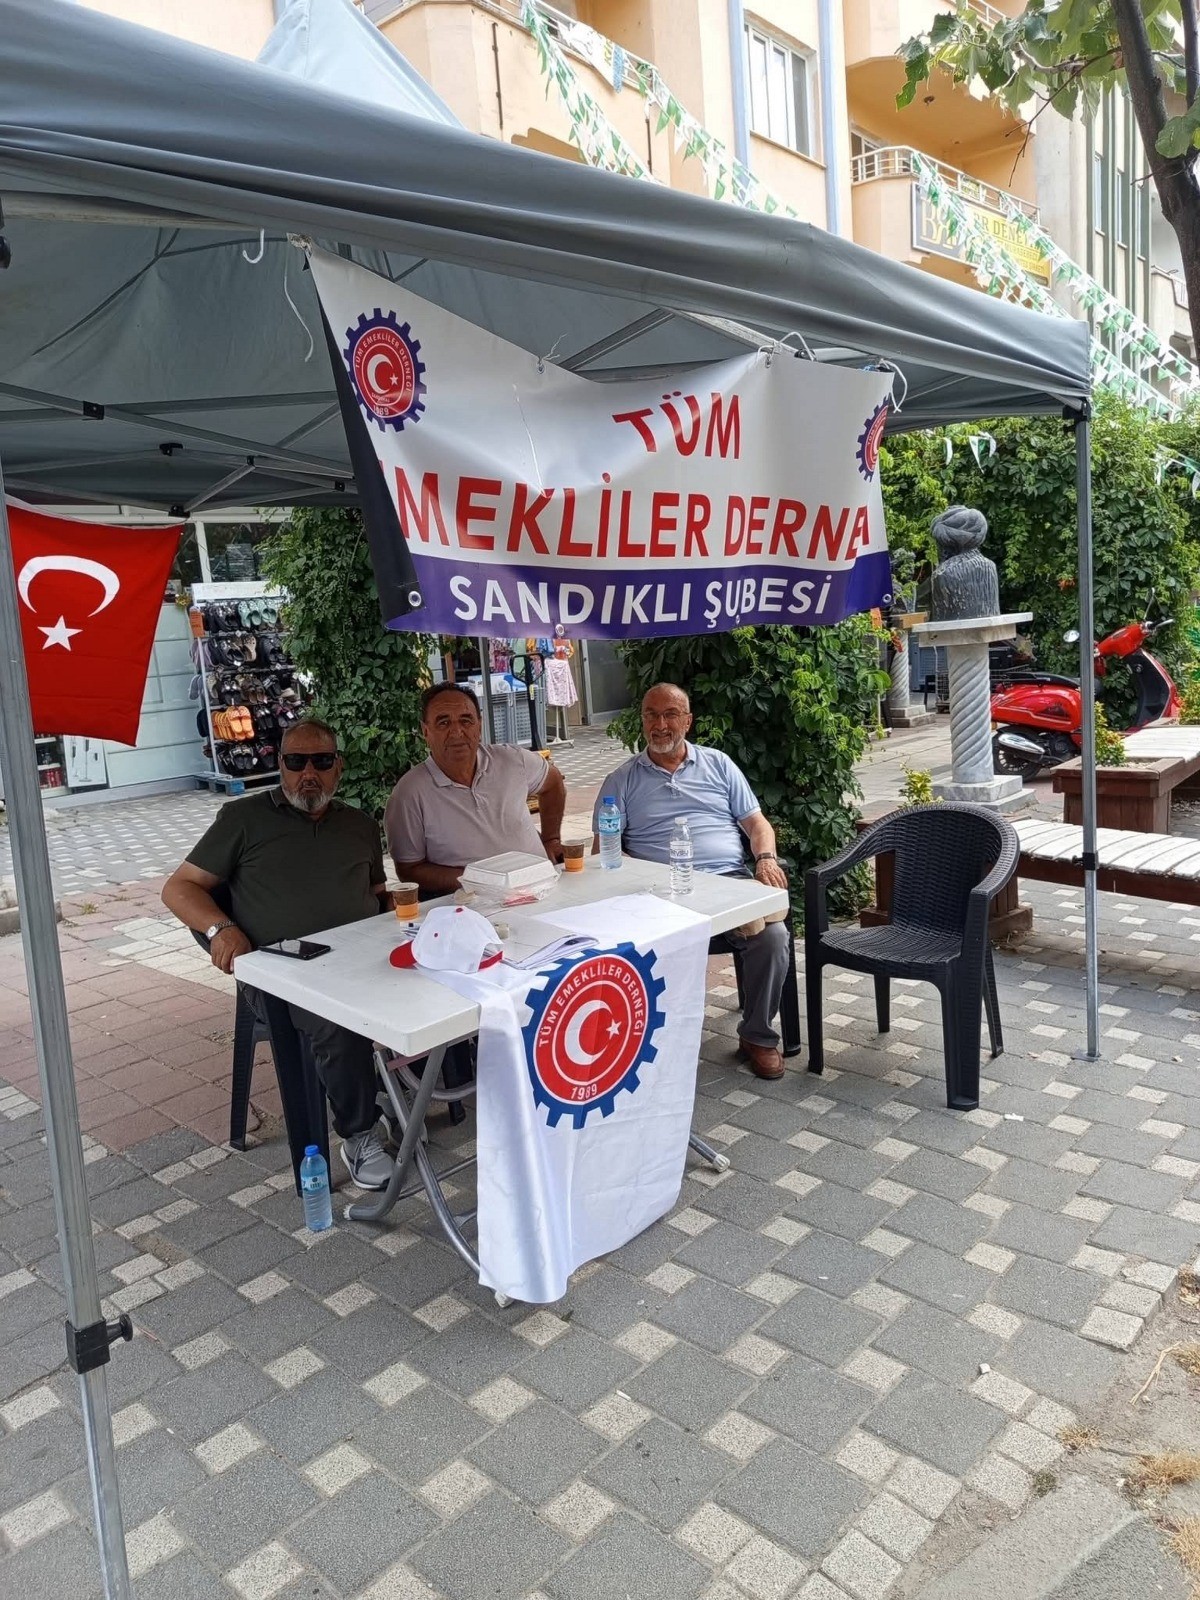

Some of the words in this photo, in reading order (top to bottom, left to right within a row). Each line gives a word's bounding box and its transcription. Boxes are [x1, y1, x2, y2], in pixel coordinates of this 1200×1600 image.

[362, 333, 400, 348] EMEKLİLER
[373, 404, 390, 416] 1989
[611, 391, 740, 460] TÜM
[379, 460, 711, 558] MEKLİLER
[449, 575, 692, 625] SANDIKLI
[703, 574, 832, 629] ŞUBESİ
[539, 1010, 559, 1048] TÜM
[556, 962, 622, 1007] EMEKLİLER
[570, 1083, 598, 1101] 1989
